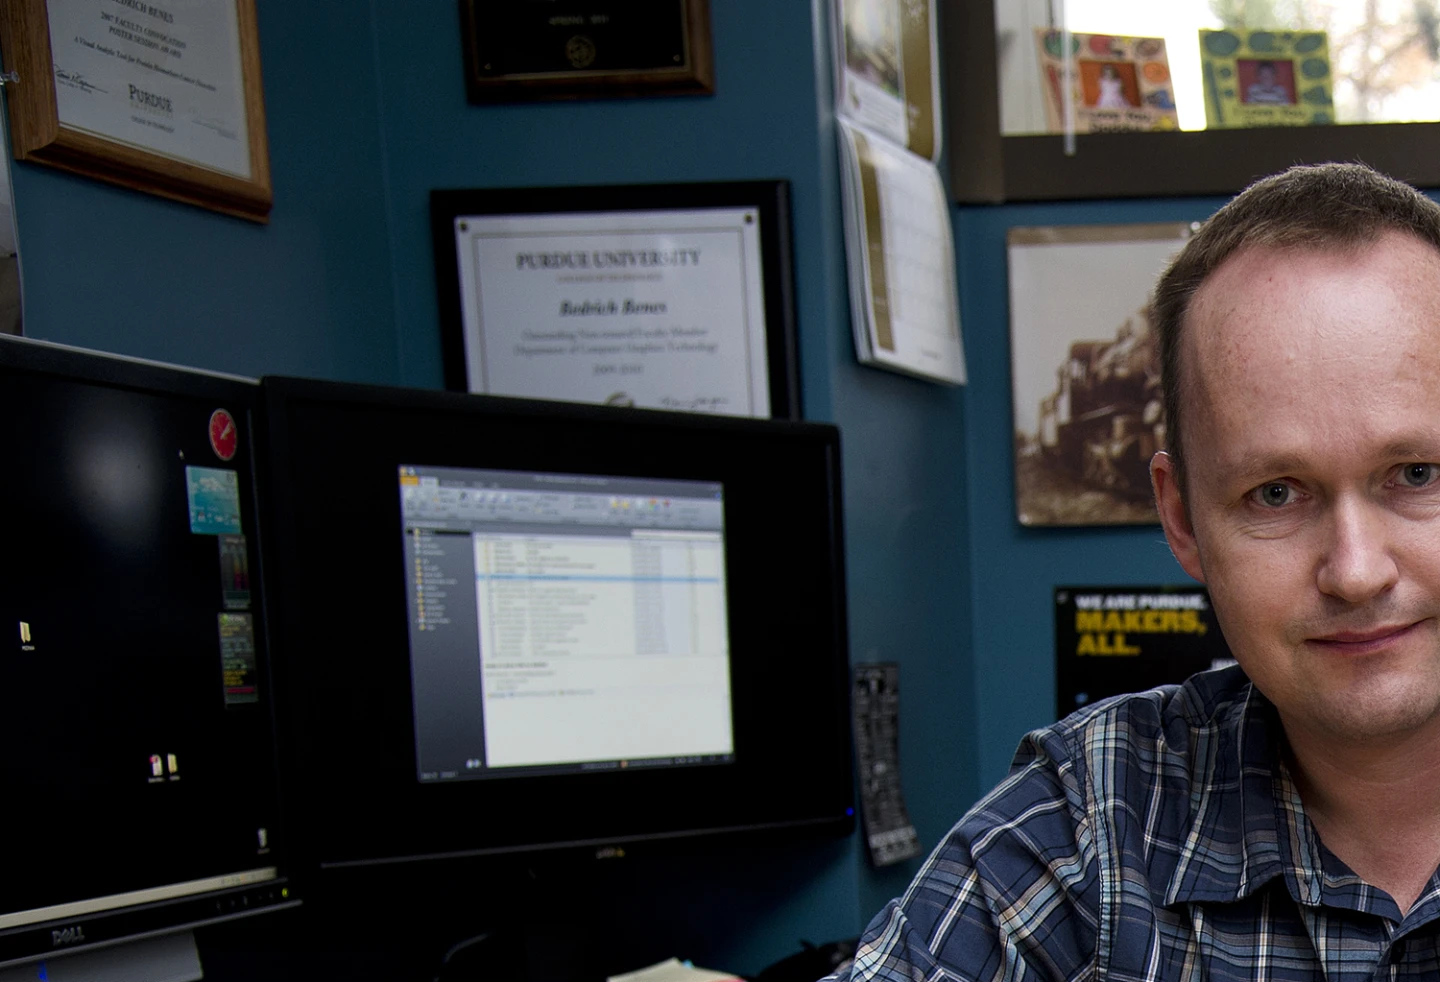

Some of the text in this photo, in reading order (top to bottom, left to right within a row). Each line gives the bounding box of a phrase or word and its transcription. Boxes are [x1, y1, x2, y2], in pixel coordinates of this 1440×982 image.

[108, 25, 133, 41] POSTER
[133, 34, 159, 50] SESSION
[128, 83, 173, 113] PURDUE
[515, 247, 702, 271] PURDUE UNIVERSITY
[1076, 633, 1141, 656] ALL.
[51, 925, 86, 948] DELL
